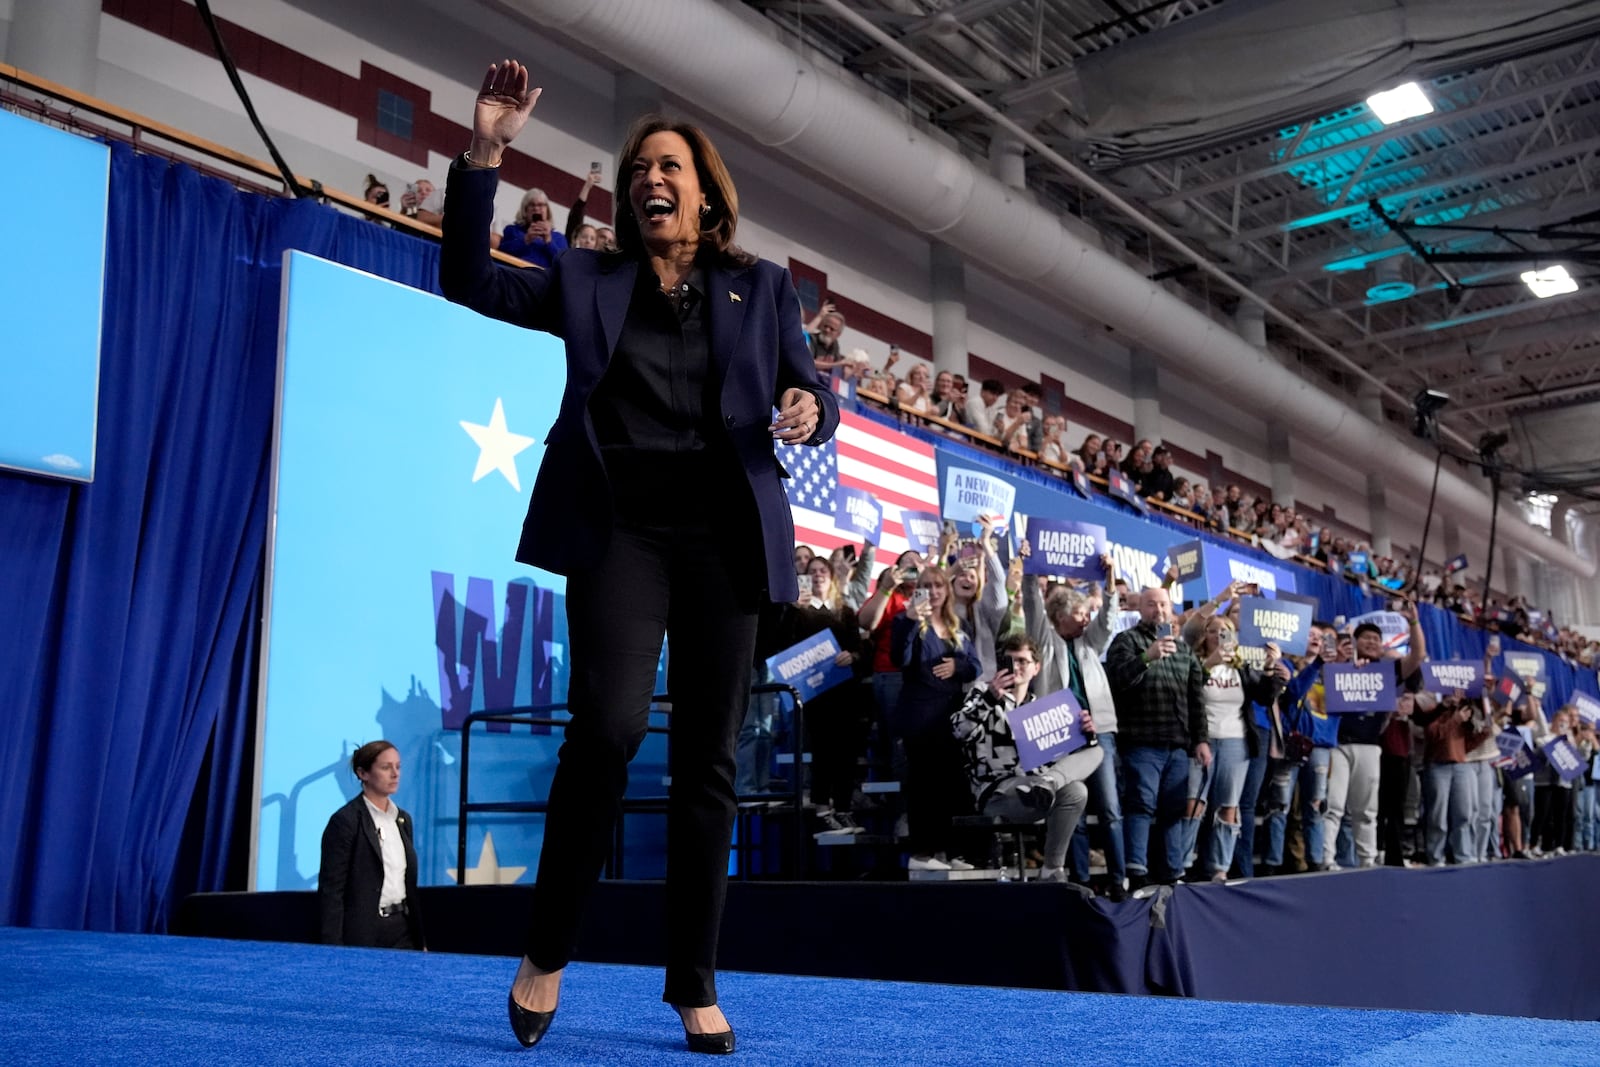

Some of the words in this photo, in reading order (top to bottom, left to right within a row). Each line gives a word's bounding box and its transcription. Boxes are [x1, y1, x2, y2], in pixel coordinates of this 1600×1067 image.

[954, 474, 962, 487] A
[965, 476, 990, 493] NEW
[957, 489, 1006, 514] FORWARD
[1038, 530, 1096, 556] HARRIS
[1046, 552, 1086, 568] WALZ
[1253, 609, 1299, 632] HARRIS
[1260, 627, 1292, 642] WALZ
[778, 639, 836, 680] WISCONSIN
[1335, 673, 1384, 691] HARRIS
[1431, 665, 1475, 682] HARRIS
[1439, 678, 1470, 689] WALZ
[1342, 690, 1377, 702] WALZ
[1022, 703, 1074, 742] HARRIS
[1036, 726, 1072, 751] WALZ
